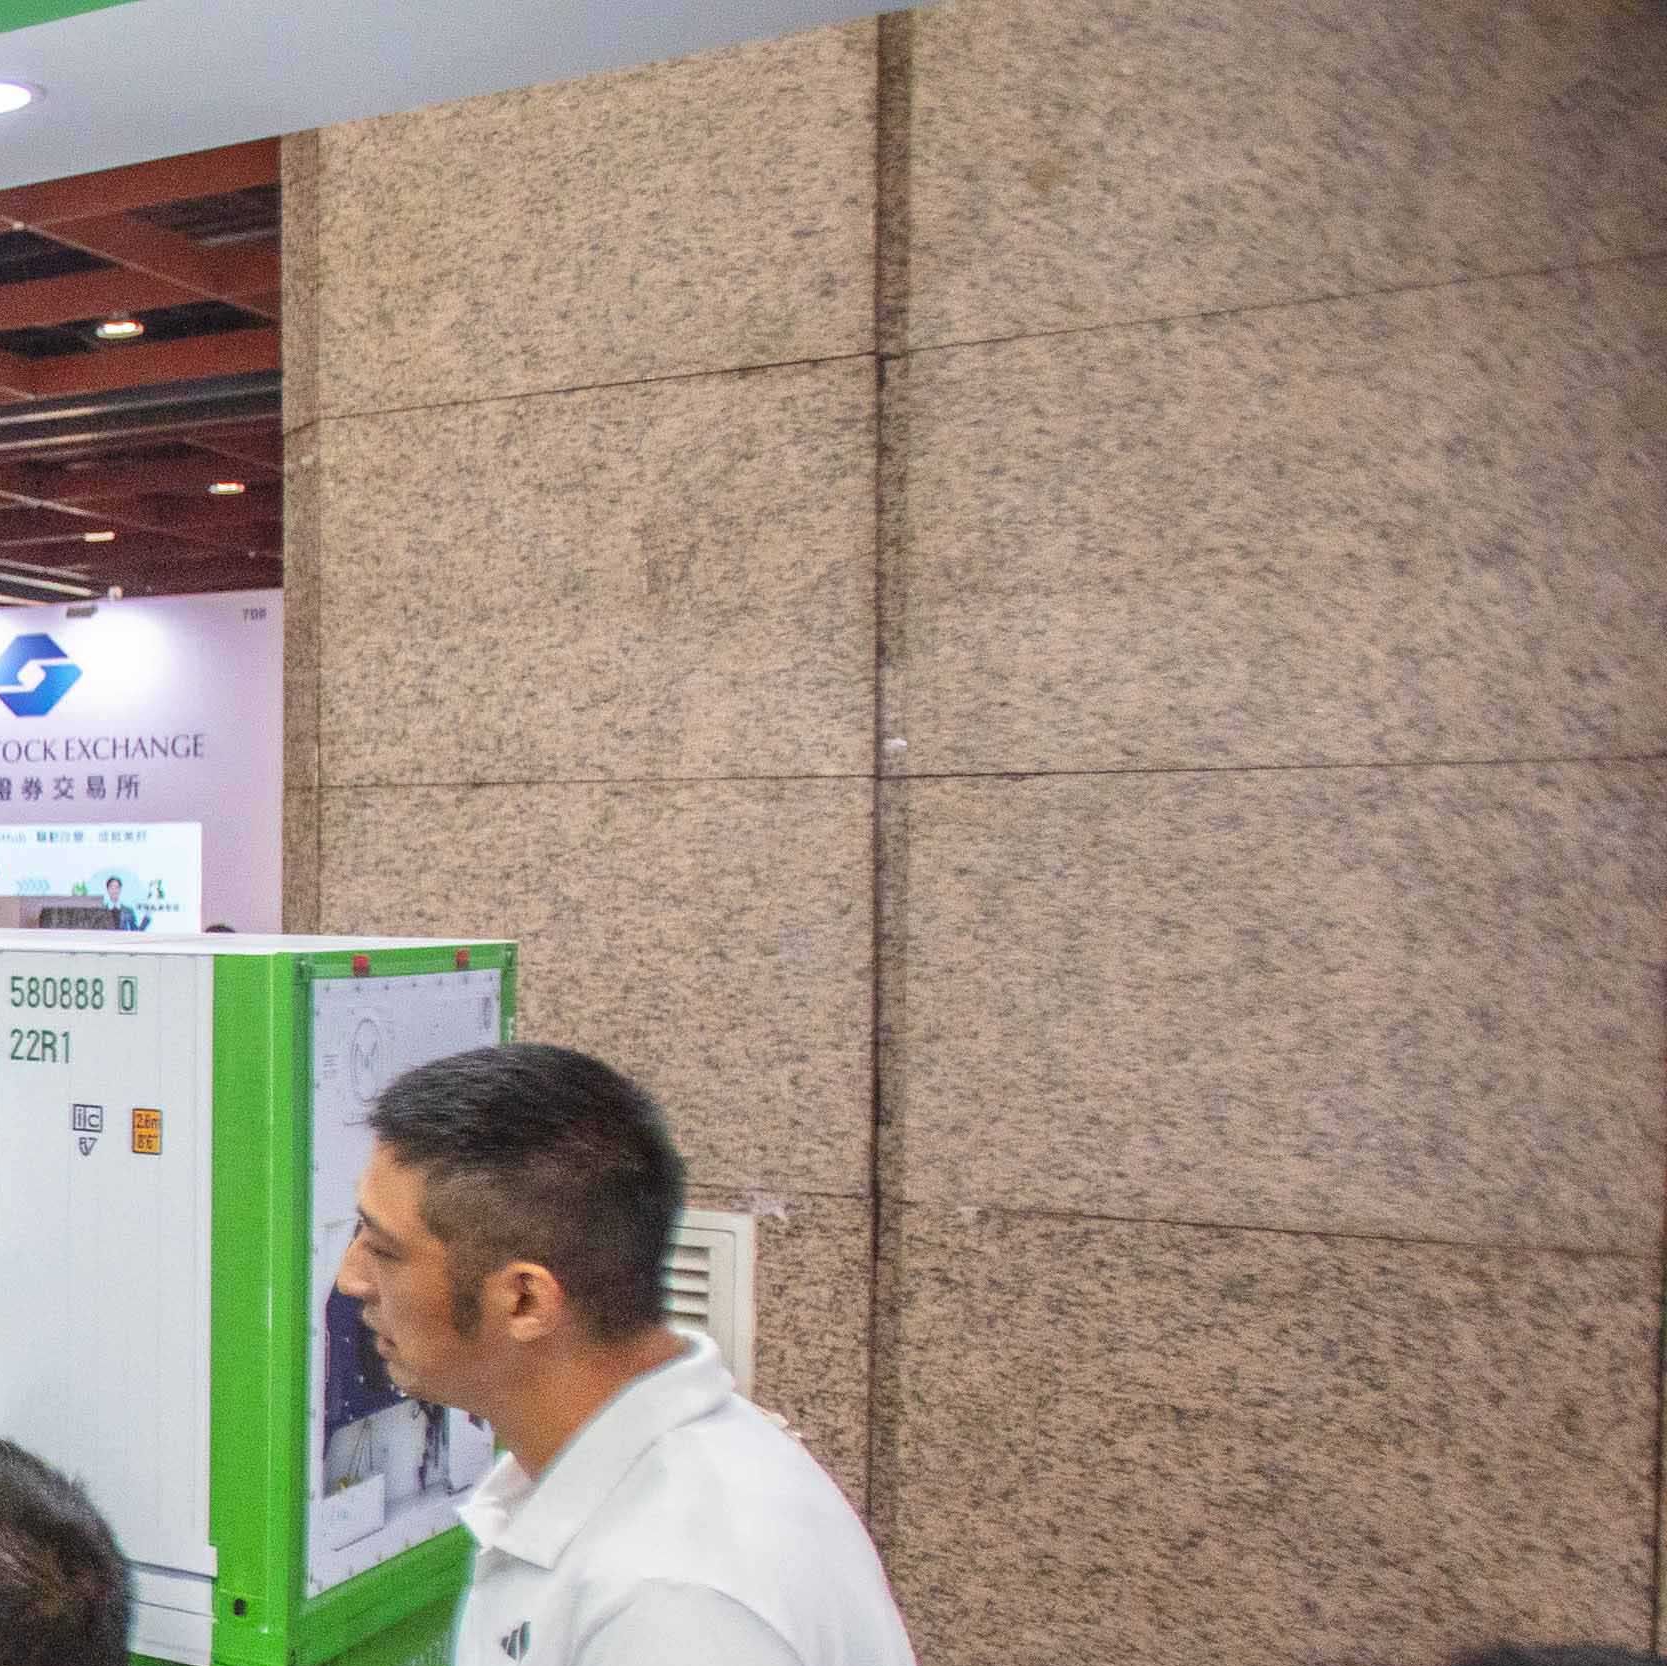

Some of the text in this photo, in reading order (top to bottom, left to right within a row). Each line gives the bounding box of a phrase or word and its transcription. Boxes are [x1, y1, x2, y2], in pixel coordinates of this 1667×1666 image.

[64, 733, 206, 762] EXCHANGE
[9, 975, 105, 1012] 580888
[121, 978, 135, 1012] 0
[9, 1028, 74, 1065] 22R1
